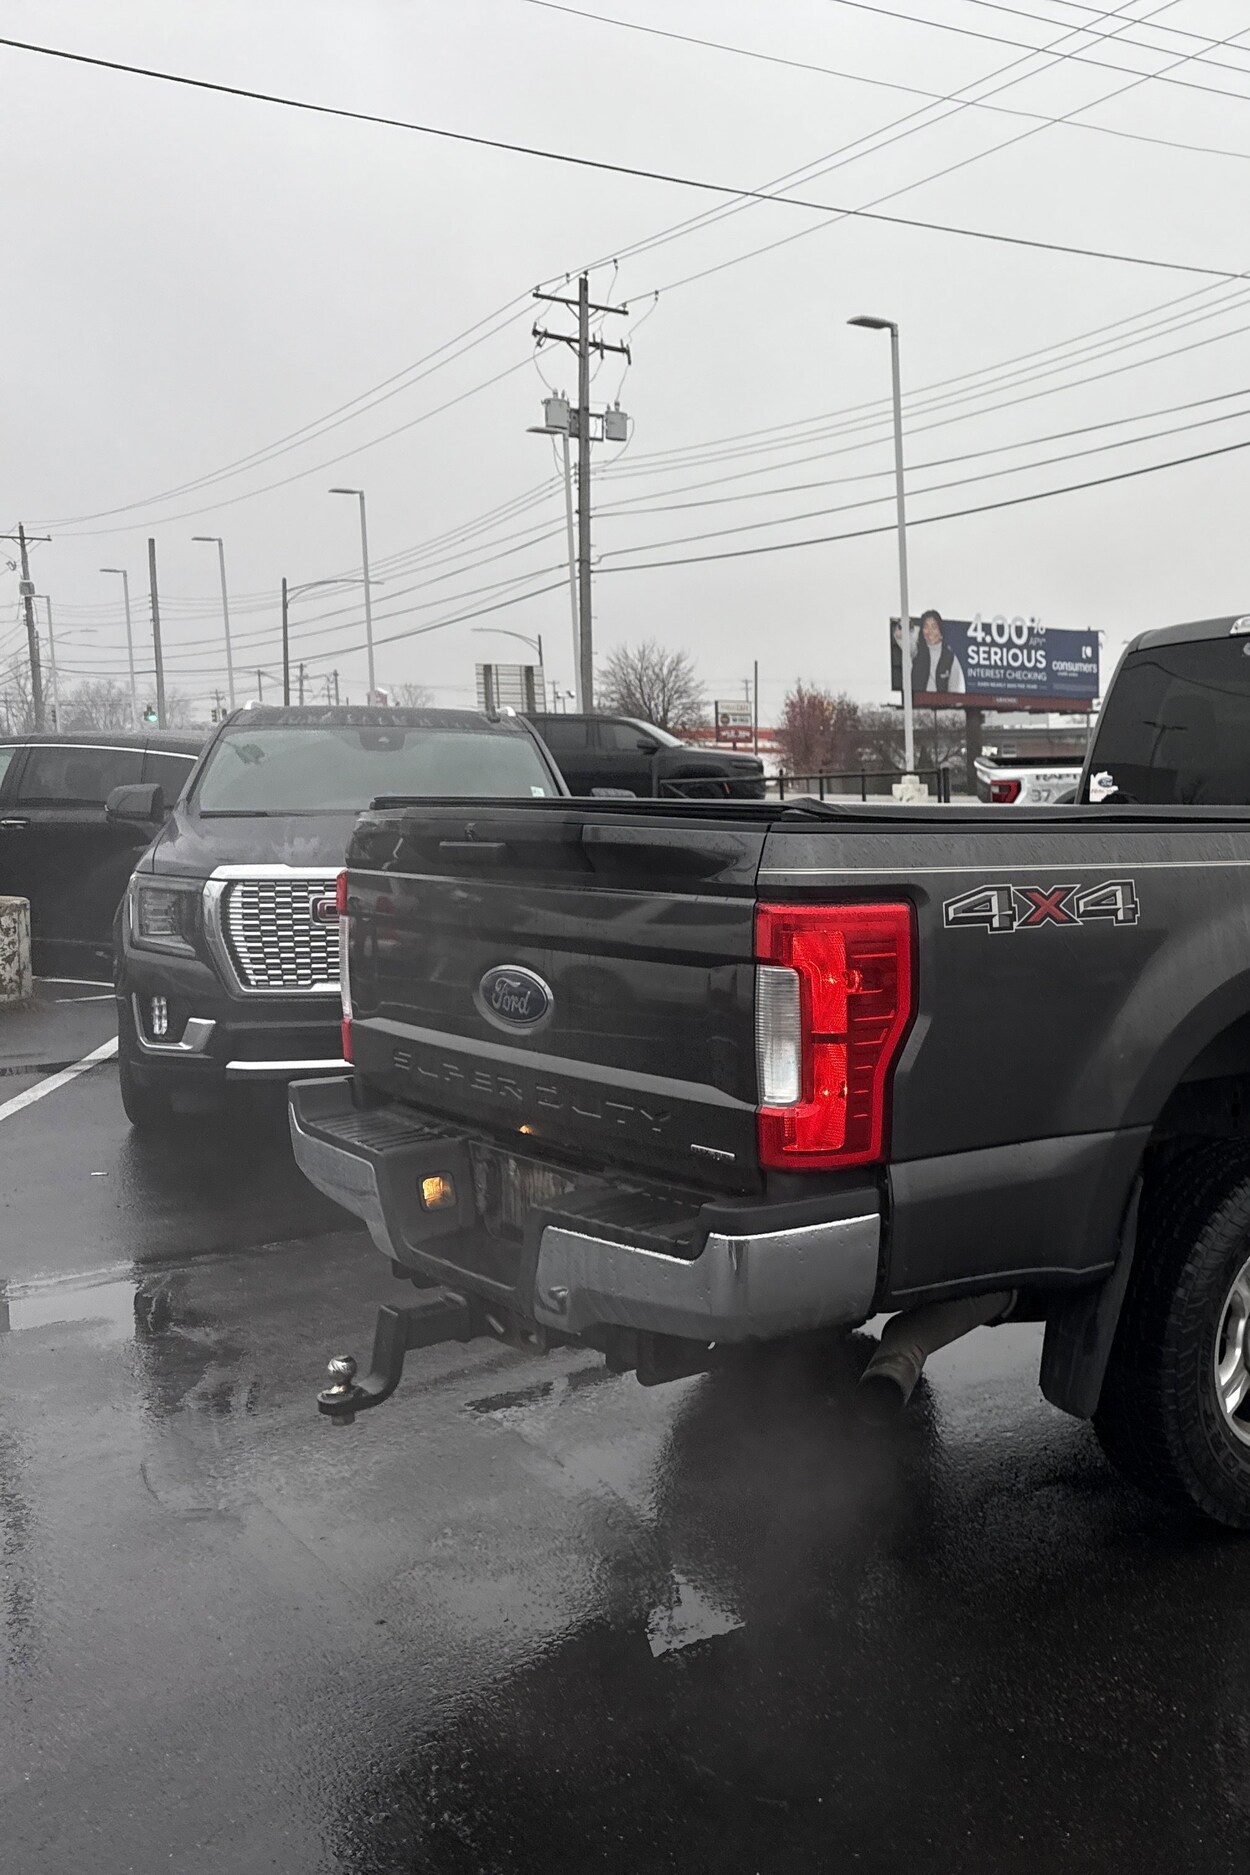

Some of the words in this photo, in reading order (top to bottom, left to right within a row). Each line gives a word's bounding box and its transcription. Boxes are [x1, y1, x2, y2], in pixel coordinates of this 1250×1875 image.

[967, 646, 1047, 669] SERIOUS
[1052, 660, 1098, 673] consumers
[967, 669, 1004, 680] INTEREST
[1006, 670, 1047, 682] CHECKING
[1031, 788, 1051, 803] 37
[942, 879, 1140, 935] 4X4
[491, 977, 531, 1015] Ford
[393, 1049, 524, 1102] SUPER
[535, 1085, 672, 1133] DUTY
